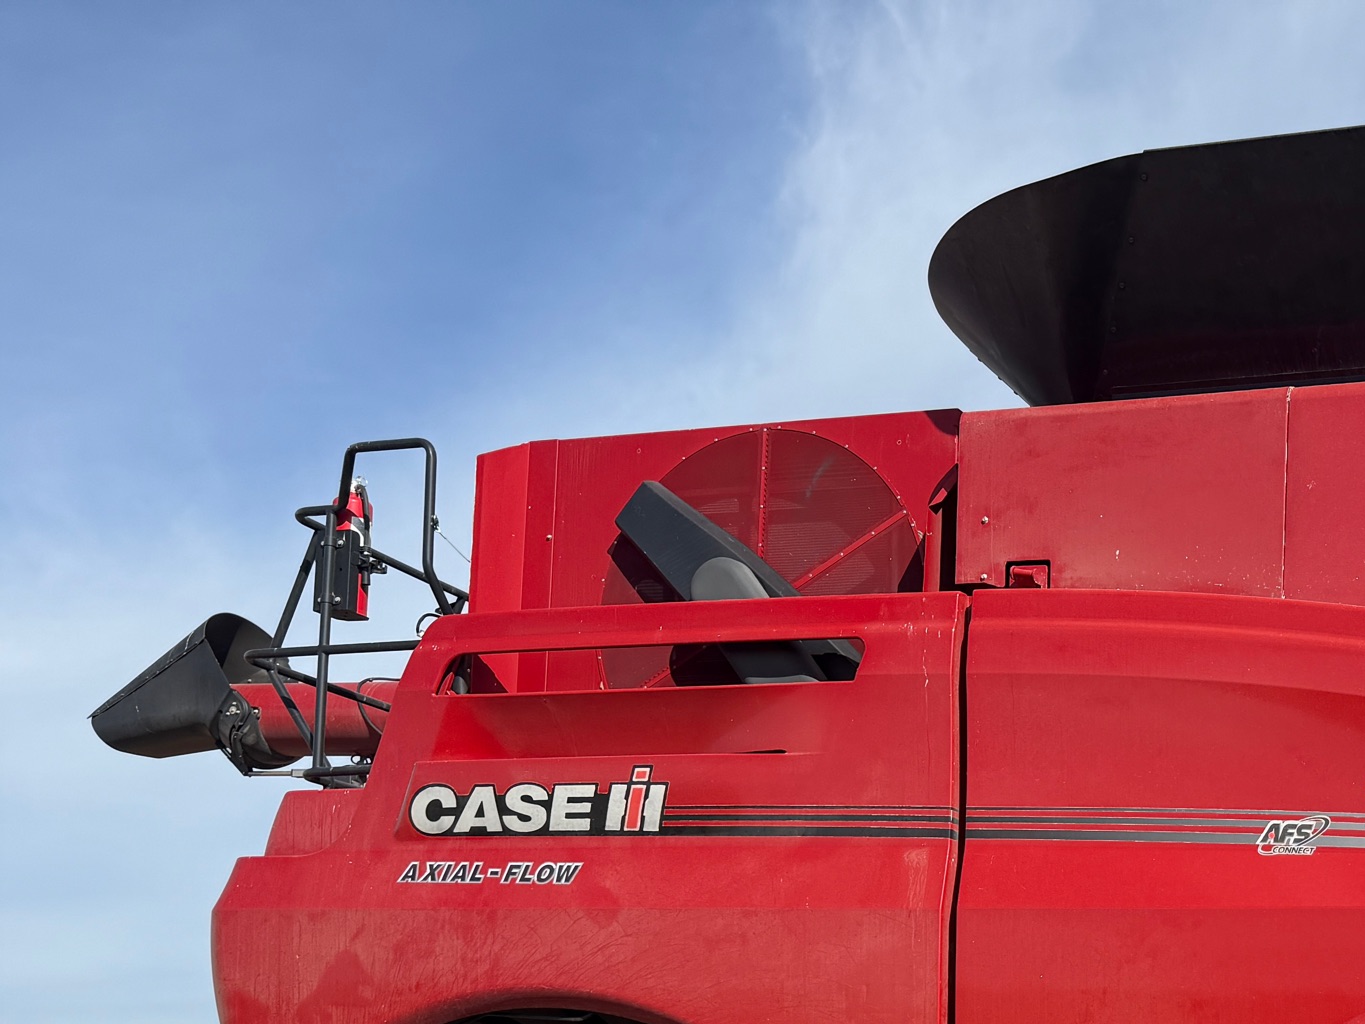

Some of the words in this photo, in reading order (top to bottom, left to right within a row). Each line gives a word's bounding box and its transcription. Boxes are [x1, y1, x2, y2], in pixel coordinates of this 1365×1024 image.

[409, 783, 598, 835] CASE
[1256, 819, 1317, 845] AFS
[1272, 845, 1316, 855] CONNECT
[397, 860, 583, 885] AXIAL-FLOW
